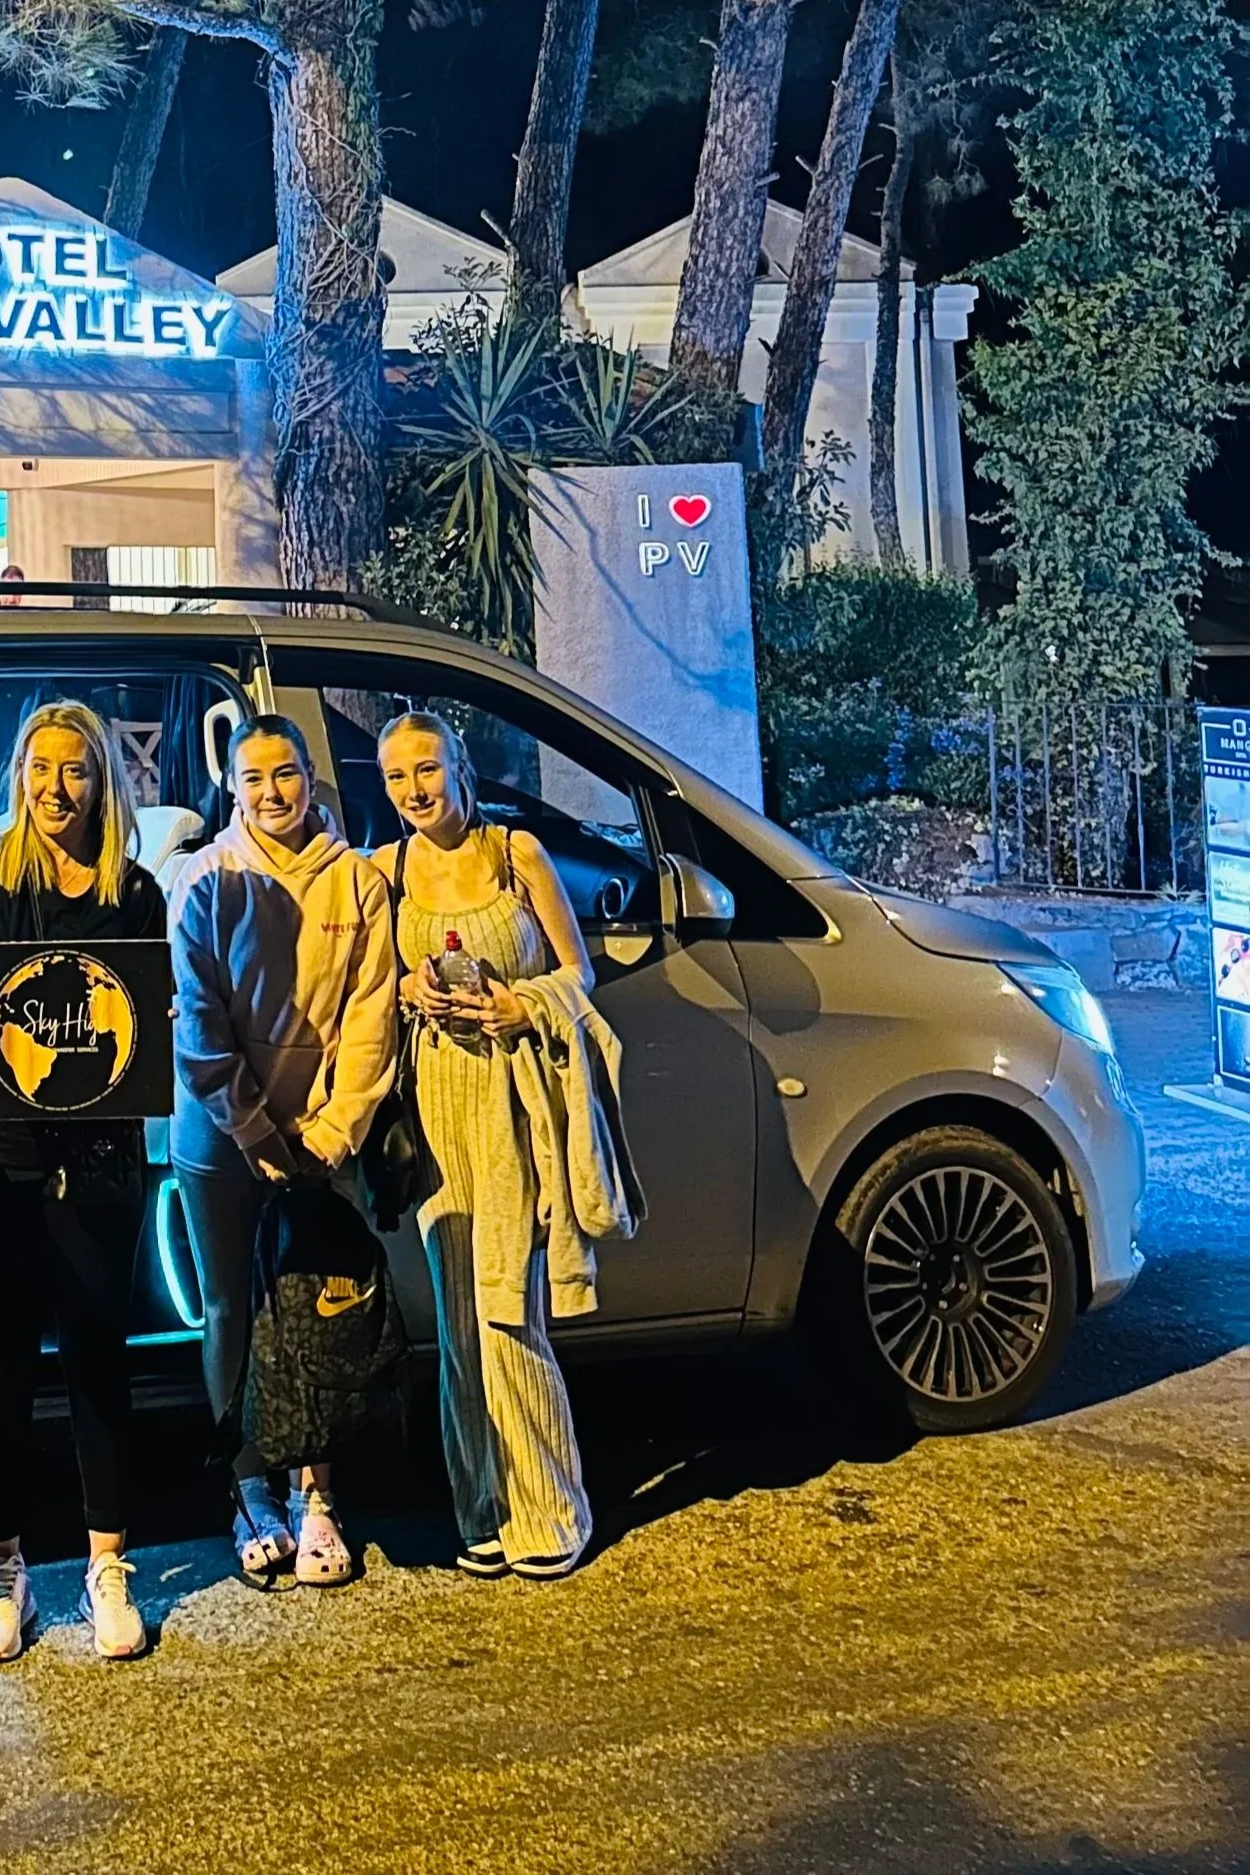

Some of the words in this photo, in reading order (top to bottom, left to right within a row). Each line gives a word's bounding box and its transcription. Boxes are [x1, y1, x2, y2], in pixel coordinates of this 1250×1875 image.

[637, 494, 650, 528] I
[638, 541, 710, 576] PV
[22, 999, 61, 1047] Sky
